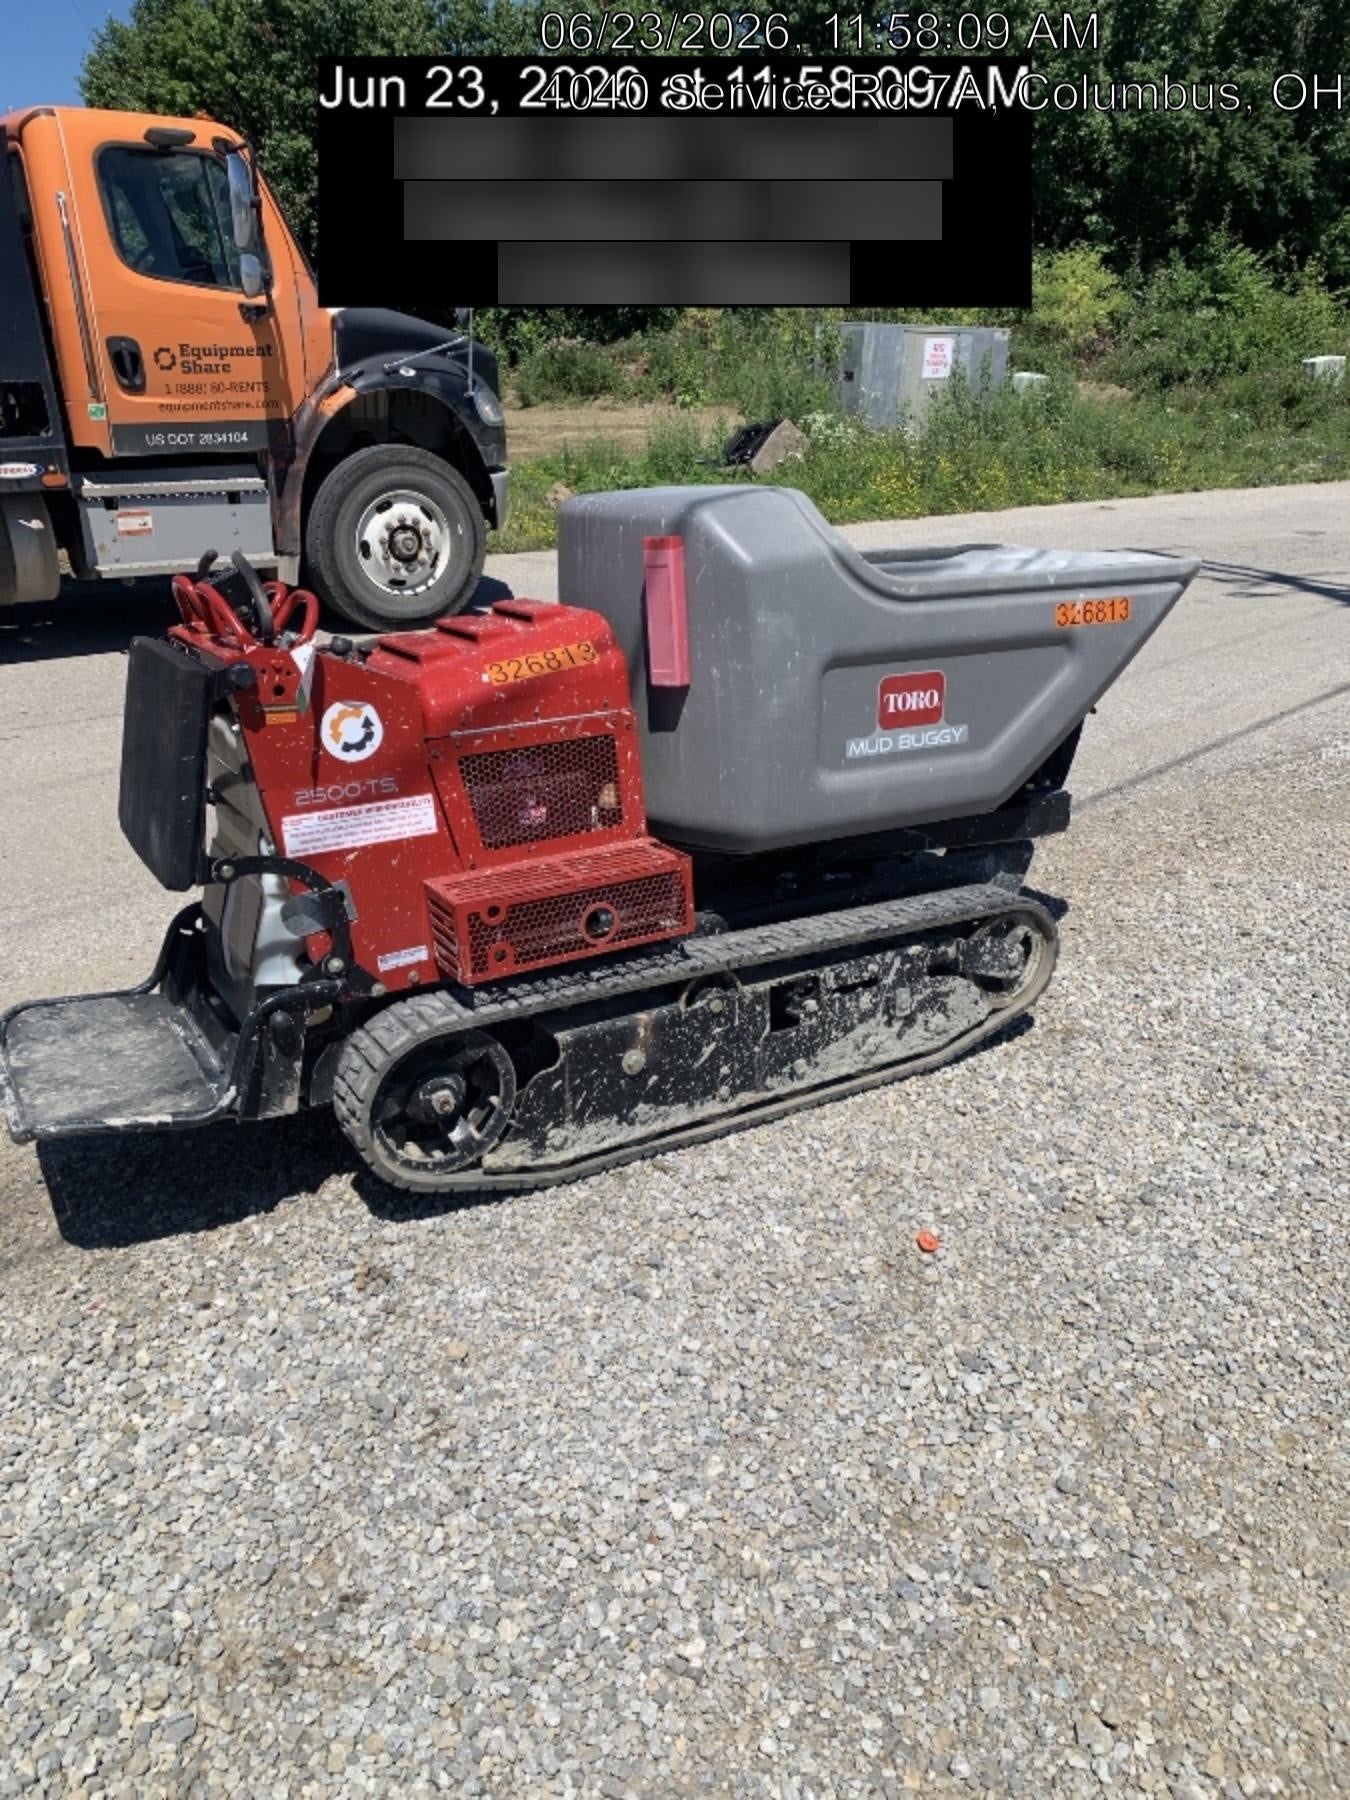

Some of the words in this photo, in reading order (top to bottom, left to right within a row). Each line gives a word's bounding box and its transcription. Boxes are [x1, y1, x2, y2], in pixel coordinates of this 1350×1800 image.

[178, 343, 273, 361] Equipment
[180, 359, 232, 375] Share
[164, 382, 172, 395] 1
[144, 433, 165, 446] US
[167, 433, 196, 446] DOT
[1056, 598, 1131, 627] 326813
[488, 642, 598, 684] 326813
[883, 690, 942, 714] TORO
[848, 734, 894, 756] MUD
[898, 728, 964, 749] BUGGY
